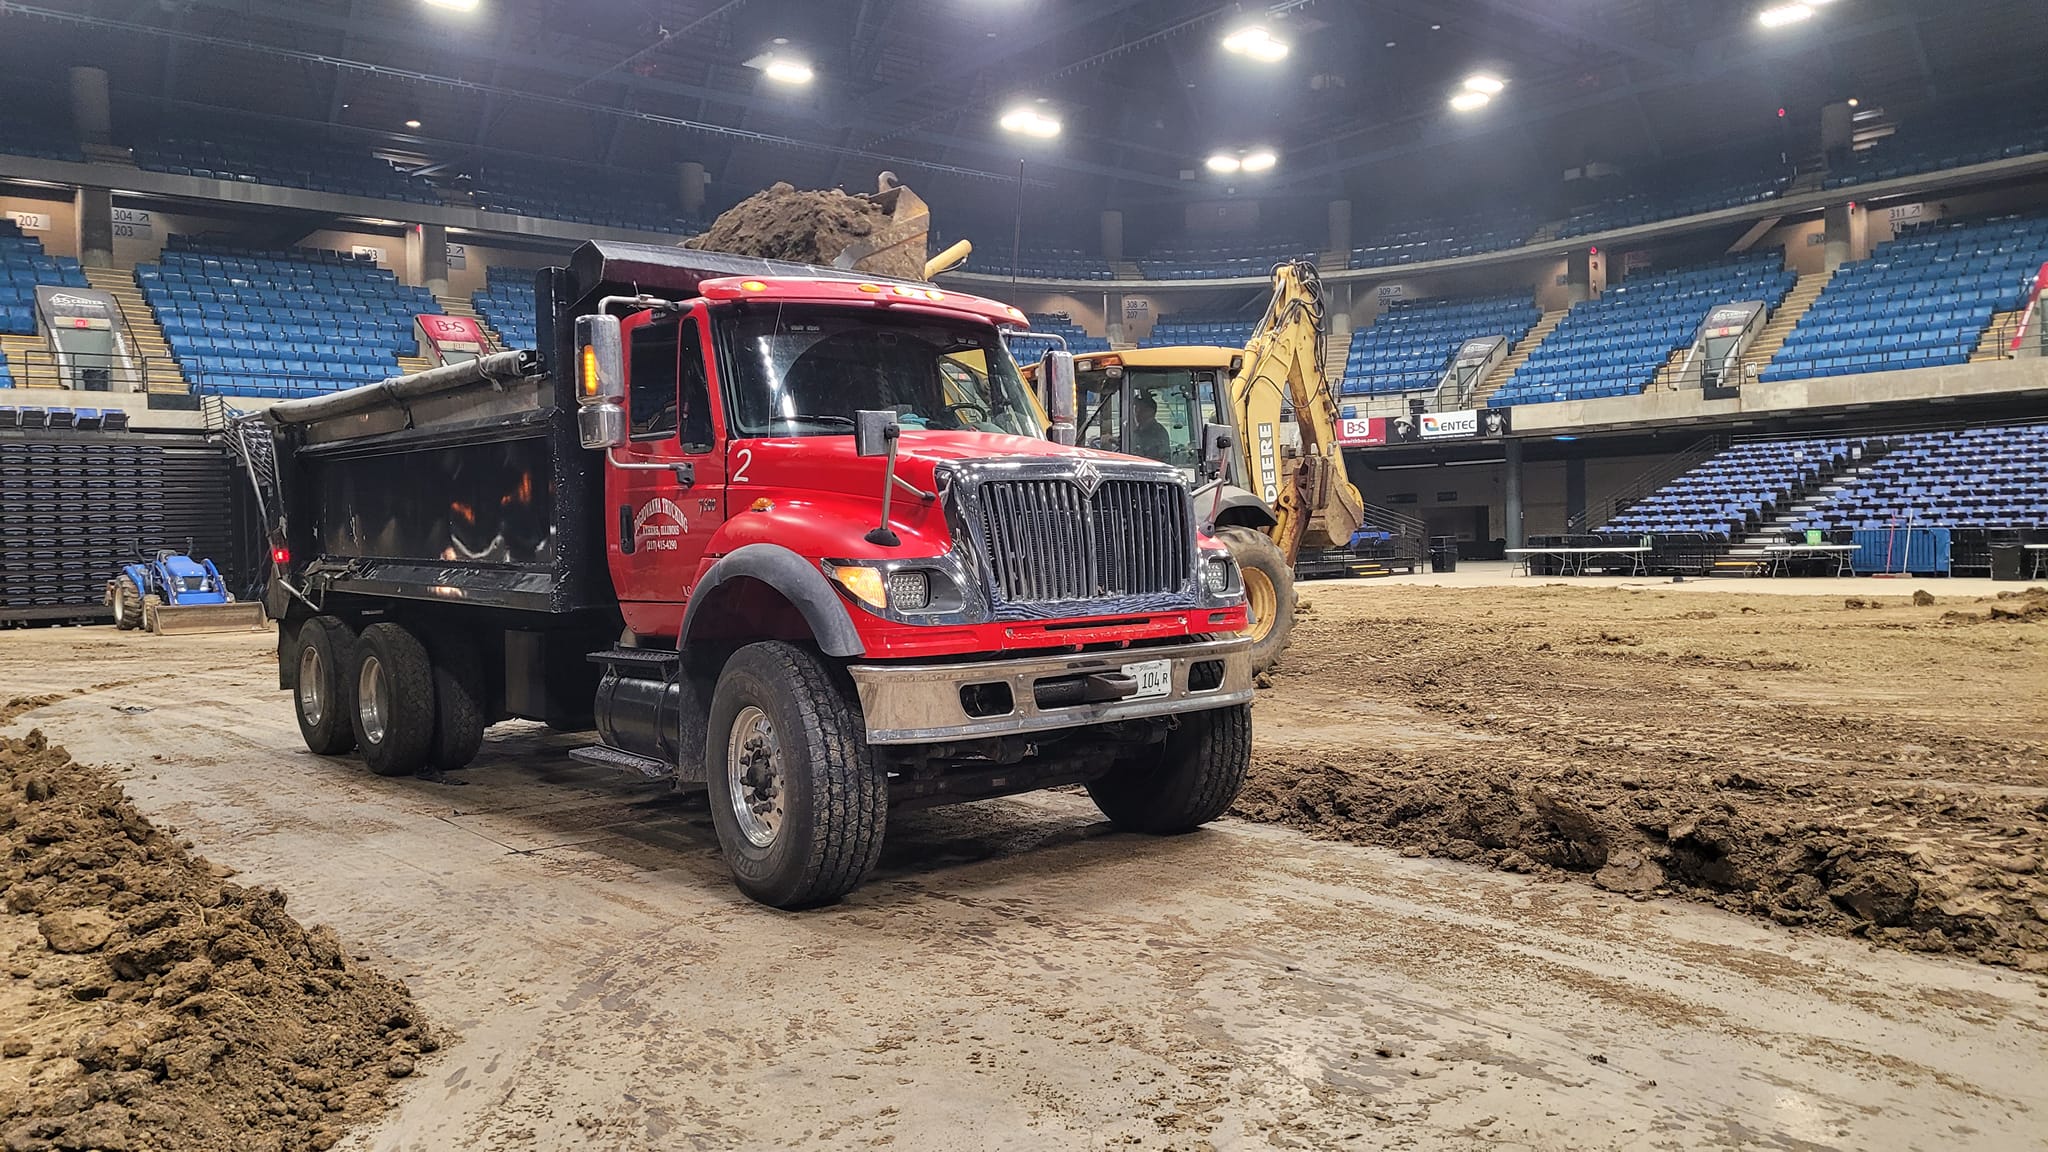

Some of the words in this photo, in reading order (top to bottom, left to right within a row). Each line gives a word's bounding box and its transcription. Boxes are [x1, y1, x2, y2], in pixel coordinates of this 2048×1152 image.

[113, 208, 133, 221] 304
[1889, 208, 1906, 219] 311
[19, 214, 39, 227] 202
[114, 224, 134, 237] 203
[1378, 287, 1391, 296] 309
[1127, 300, 1138, 309] 308
[1127, 310, 1138, 319] 207
[1440, 419, 1476, 432] ENTEC
[733, 448, 752, 482] 2
[1259, 423, 1278, 504] DEERE
